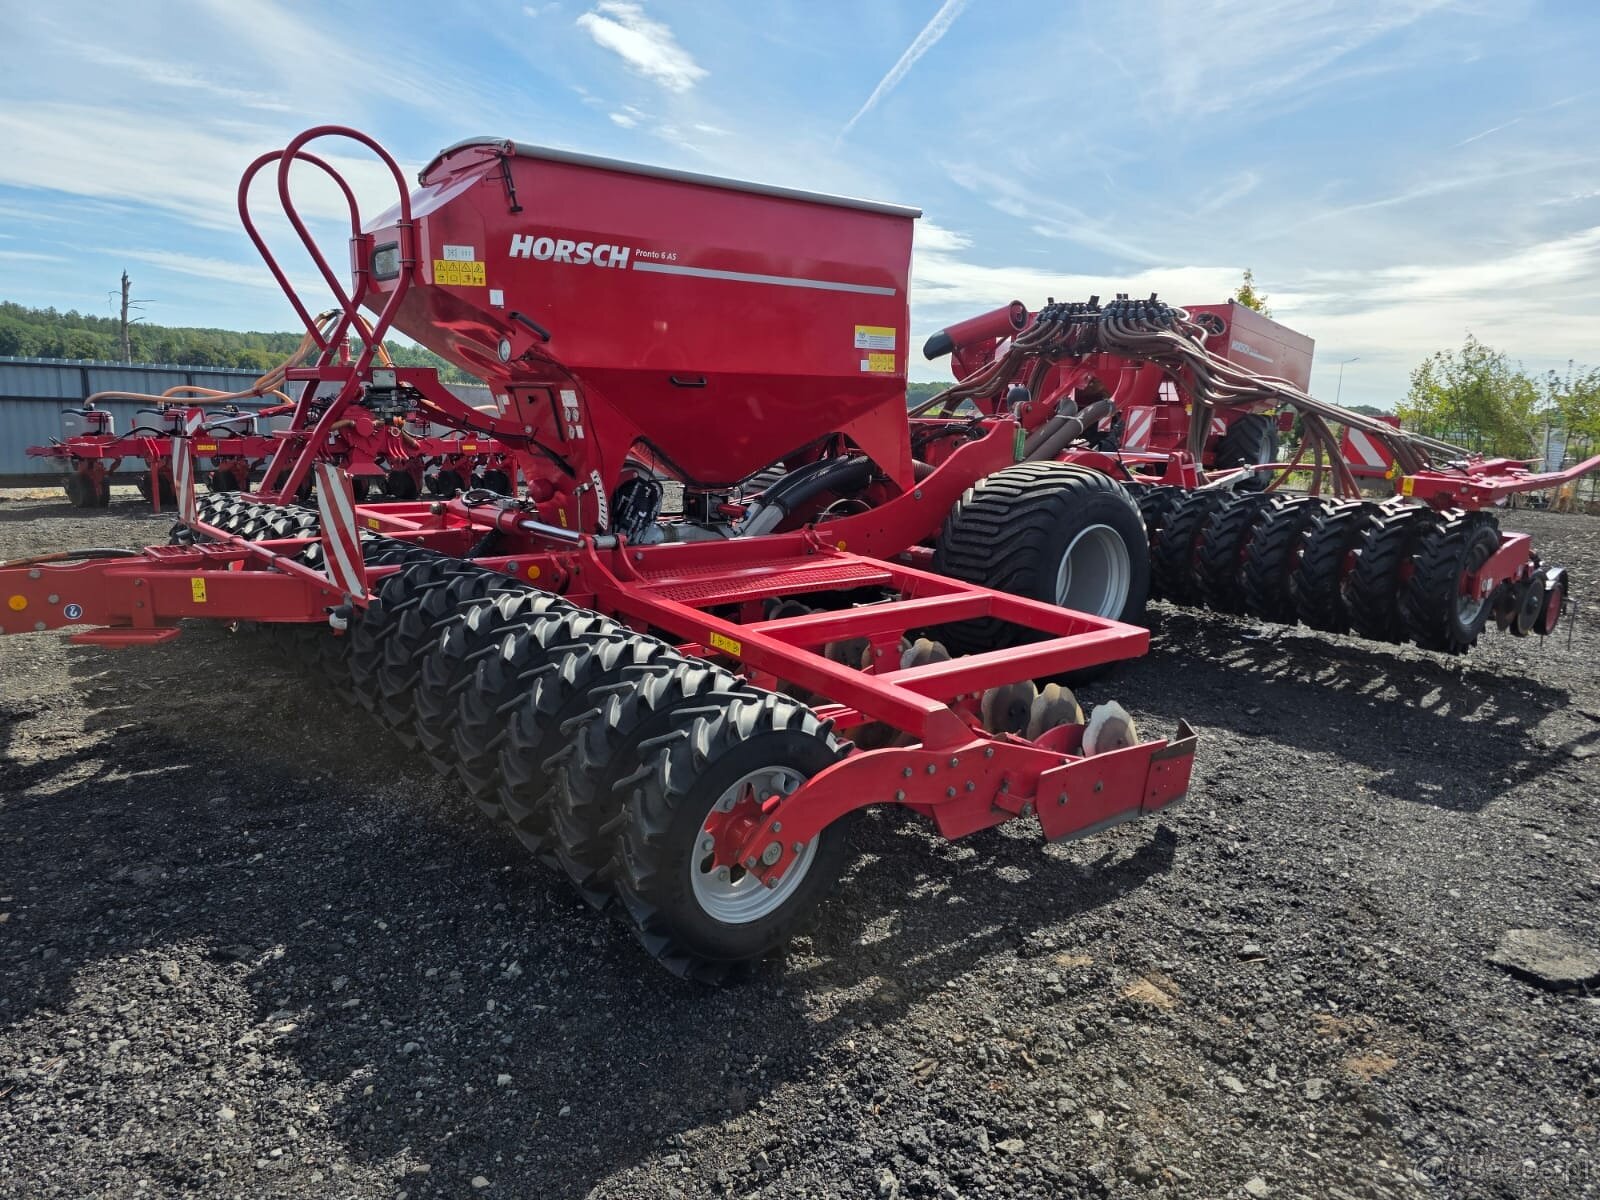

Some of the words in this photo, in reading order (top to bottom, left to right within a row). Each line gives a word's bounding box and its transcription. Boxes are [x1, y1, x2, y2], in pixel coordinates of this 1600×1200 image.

[509, 234, 630, 268] HORSCH
[635, 248, 660, 259] Pronto
[661, 251, 666, 259] 6
